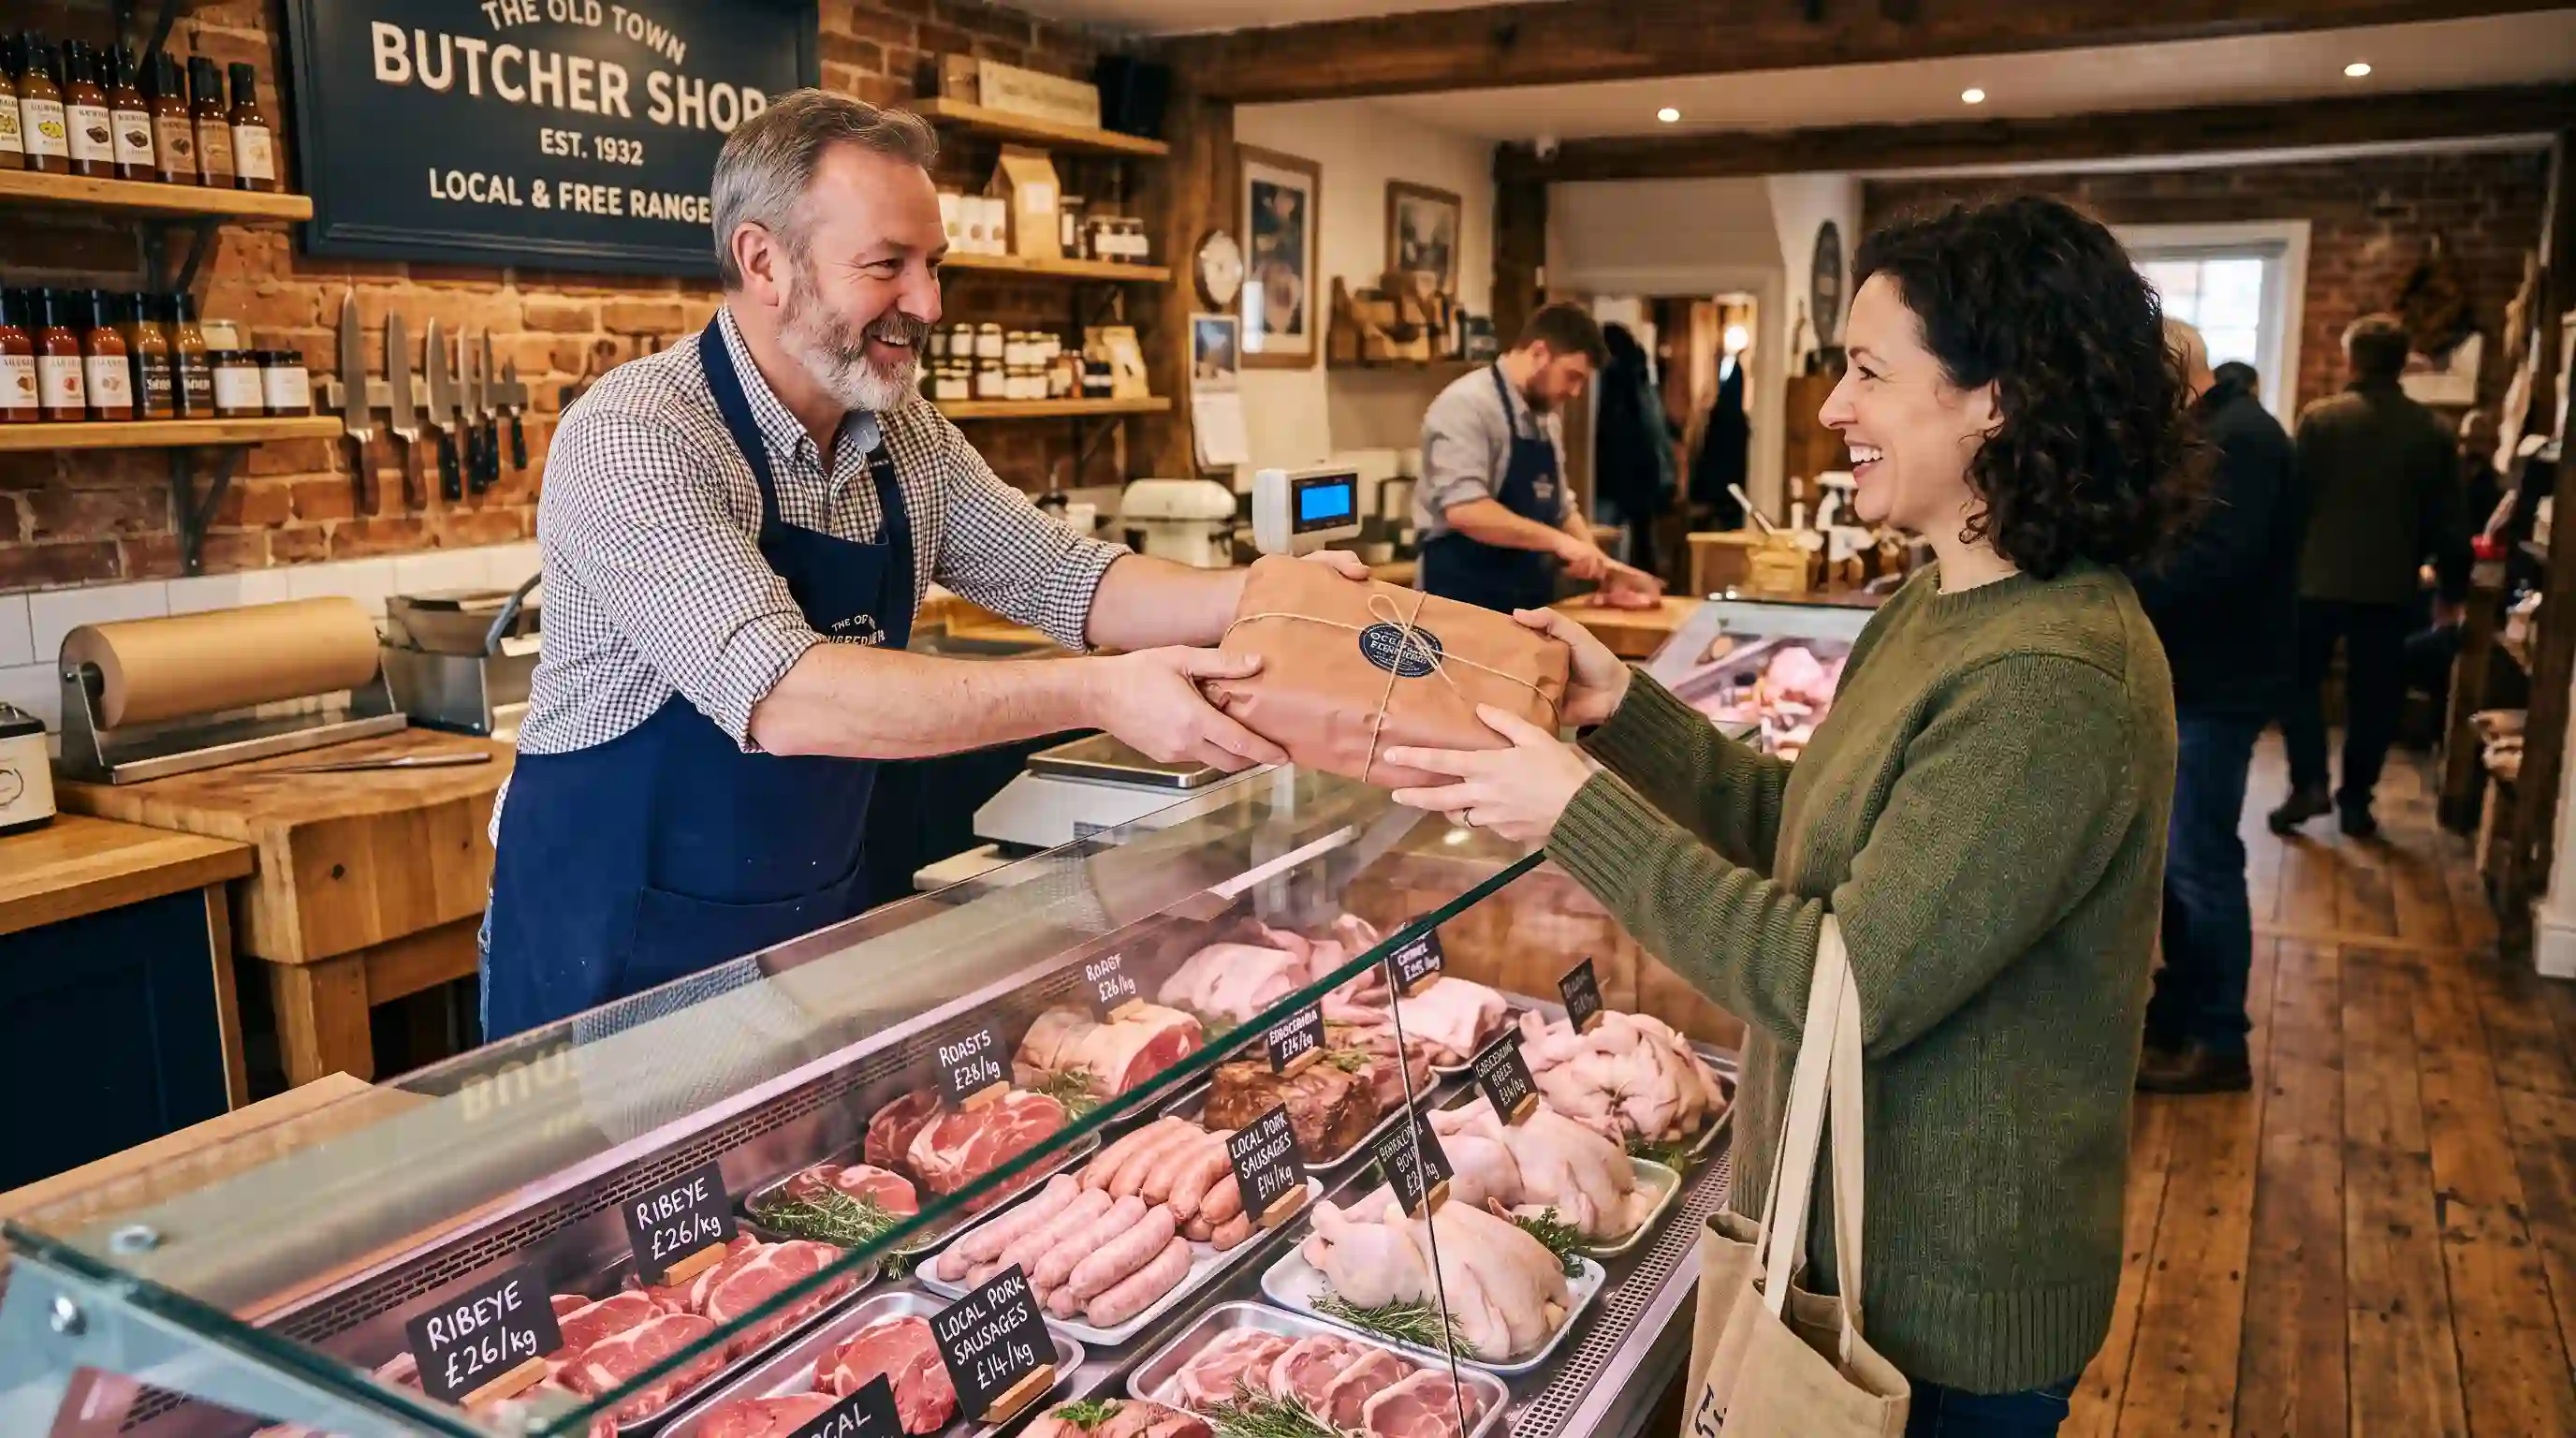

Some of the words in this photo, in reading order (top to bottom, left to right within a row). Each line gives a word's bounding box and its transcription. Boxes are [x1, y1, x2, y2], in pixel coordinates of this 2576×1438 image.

[481, 0, 541, 31] THE
[548, 0, 602, 28] OLD
[611, 6, 687, 66] TOWN
[372, 21, 632, 119] BUTCHER
[540, 128, 589, 159] EST.
[594, 136, 644, 167] 1932
[429, 168, 524, 207] LOCAL
[531, 180, 550, 209] &
[559, 182, 623, 216] FREE
[630, 192, 711, 225] RANGE
[939, 1030, 991, 1068] ROASTS
[1231, 1128, 1263, 1159] LOCAL
[1241, 1131, 1292, 1180] SAUSAGES
[637, 1177, 709, 1230] RIBEYE
[651, 1213, 722, 1261] £26/kg
[426, 1280, 522, 1352] RIBEYE
[939, 1303, 987, 1343] LOCAL
[987, 1275, 1026, 1310] PORK
[953, 1301, 1029, 1366] SAUSAGES
[445, 1327, 537, 1389] £26/kg
[976, 1341, 1035, 1391] £14/kg
